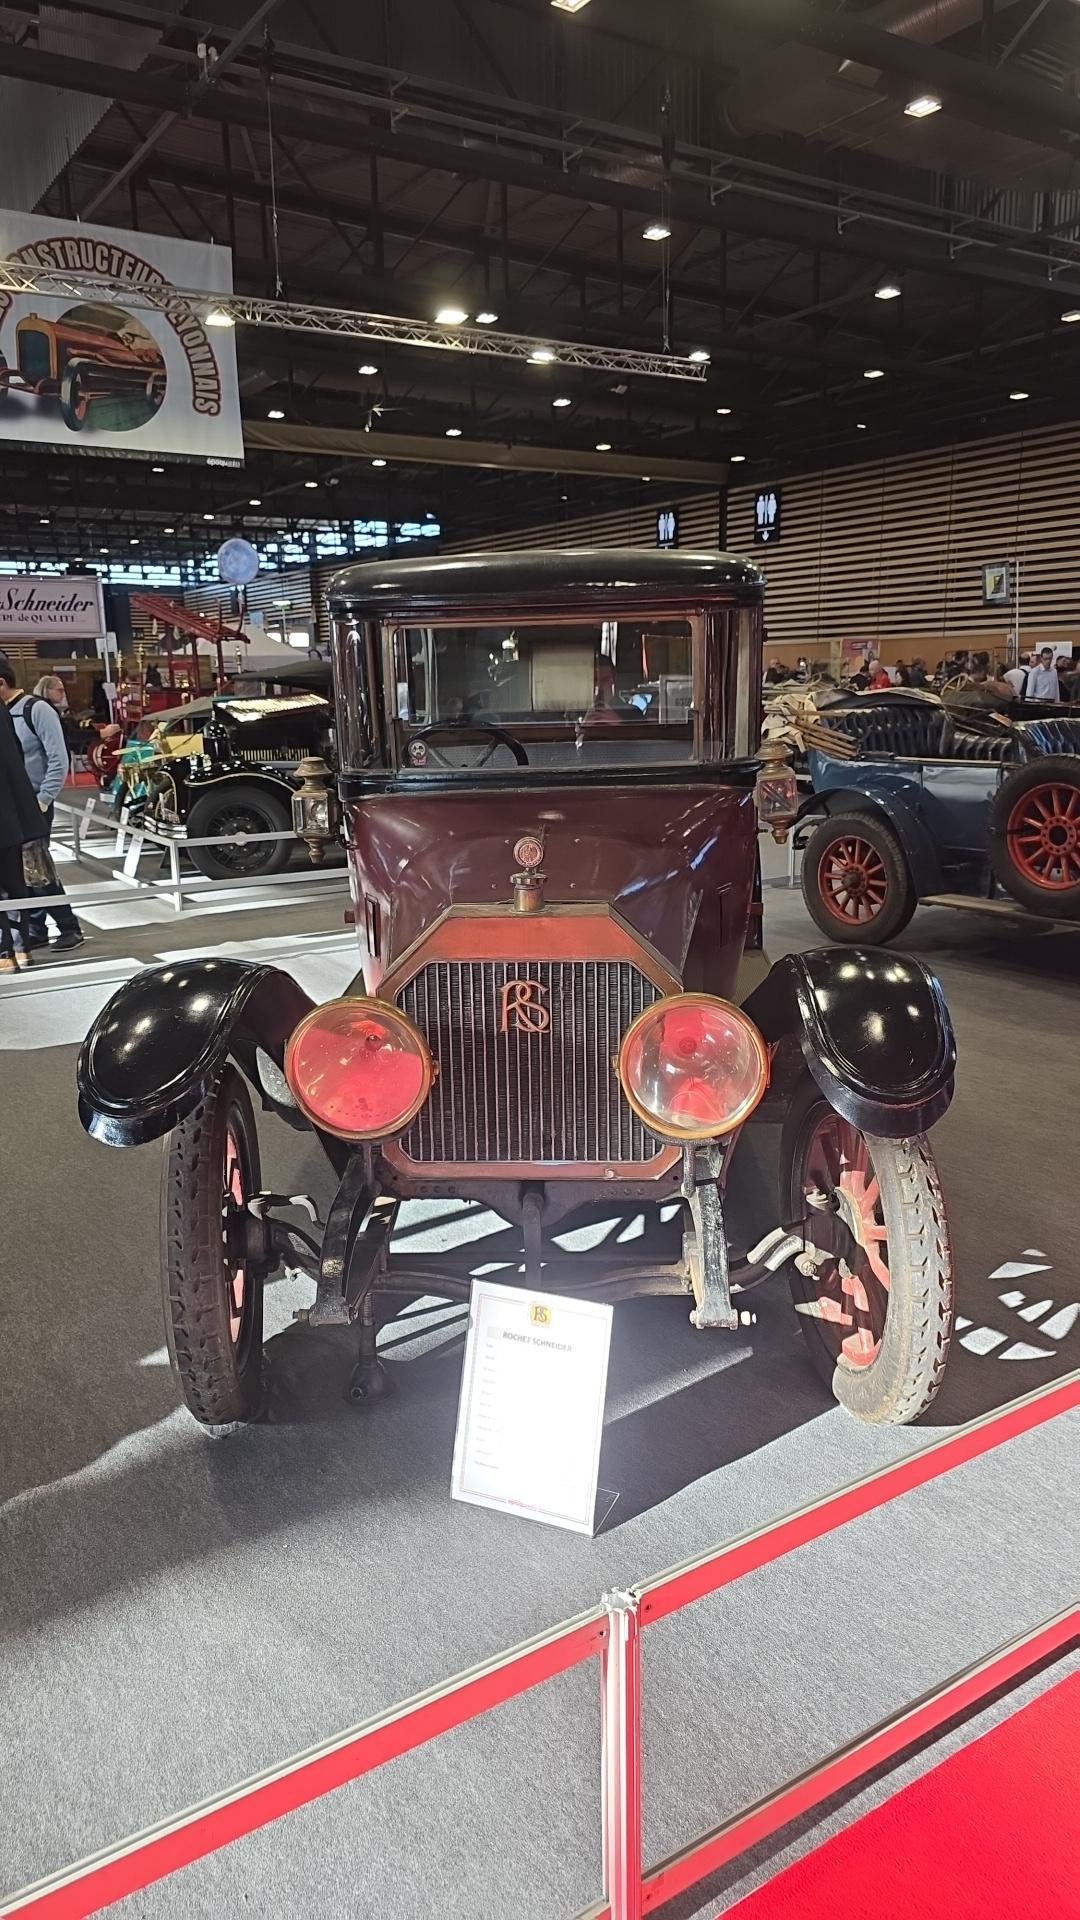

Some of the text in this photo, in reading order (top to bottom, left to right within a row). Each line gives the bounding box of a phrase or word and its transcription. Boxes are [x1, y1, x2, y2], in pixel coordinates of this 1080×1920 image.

[6, 587, 94, 612] Schneider
[18, 613, 29, 622] de
[499, 980, 550, 1033] RS
[533, 1305, 548, 1323] RS
[502, 1331, 573, 1352] ROCHET SCHNEIDER
